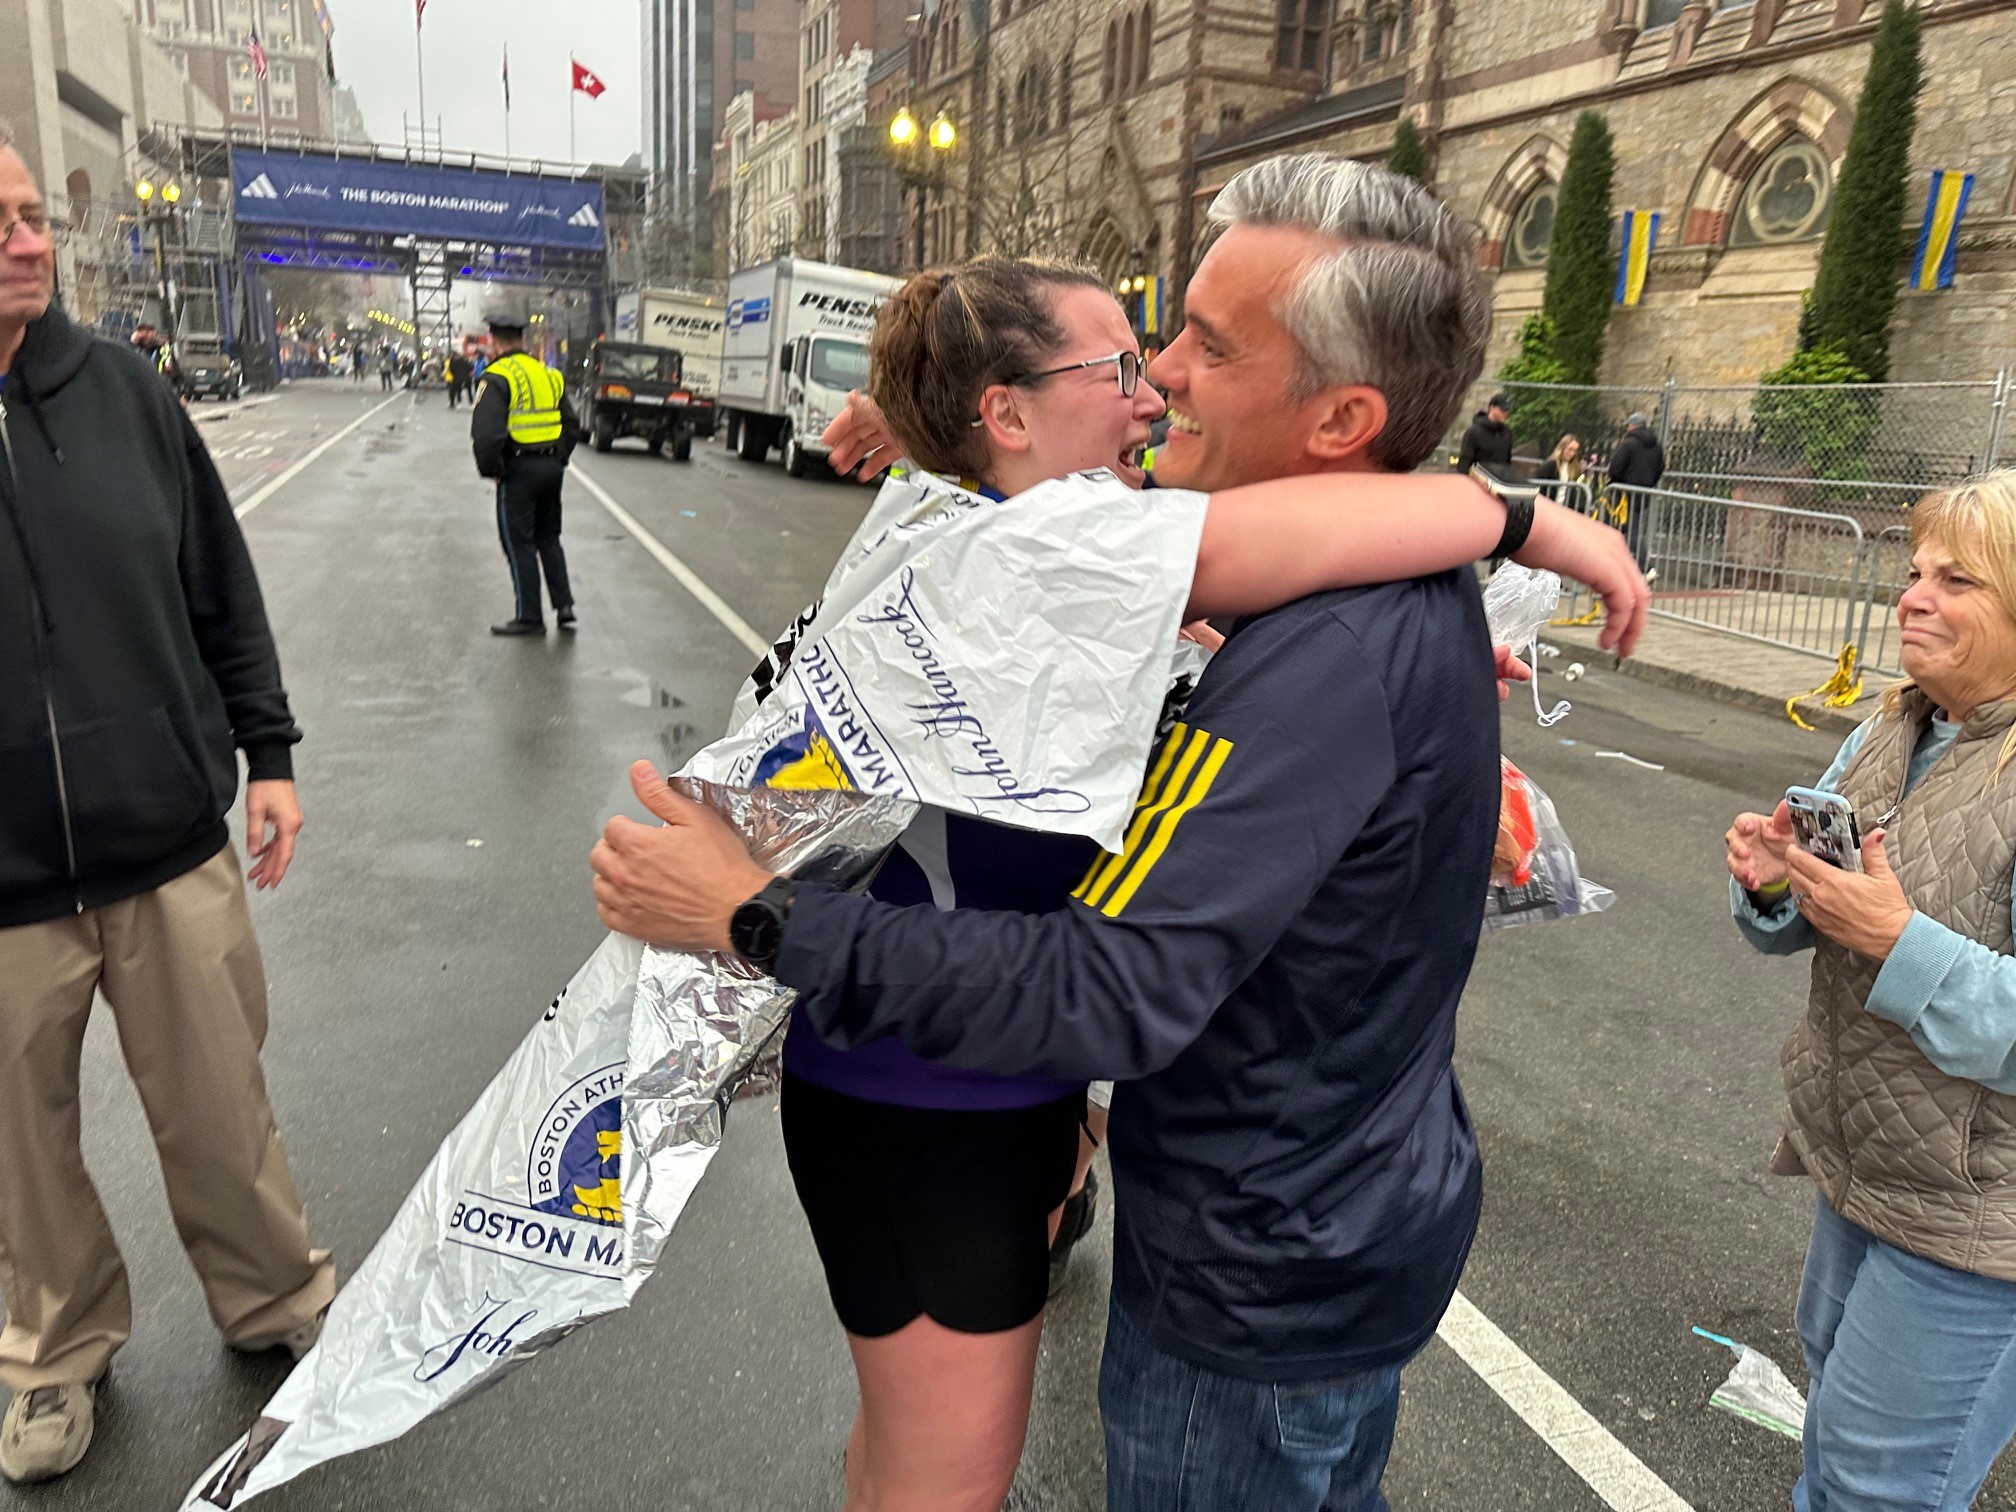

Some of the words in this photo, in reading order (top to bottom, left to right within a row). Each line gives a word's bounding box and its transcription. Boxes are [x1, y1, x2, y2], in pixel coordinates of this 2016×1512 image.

[339, 186, 369, 203] THE
[370, 189, 427, 207] BOSTON
[819, 315, 845, 326] Truck
[537, 1099, 582, 1195] BOSTON
[450, 1201, 576, 1258] BOSTON
